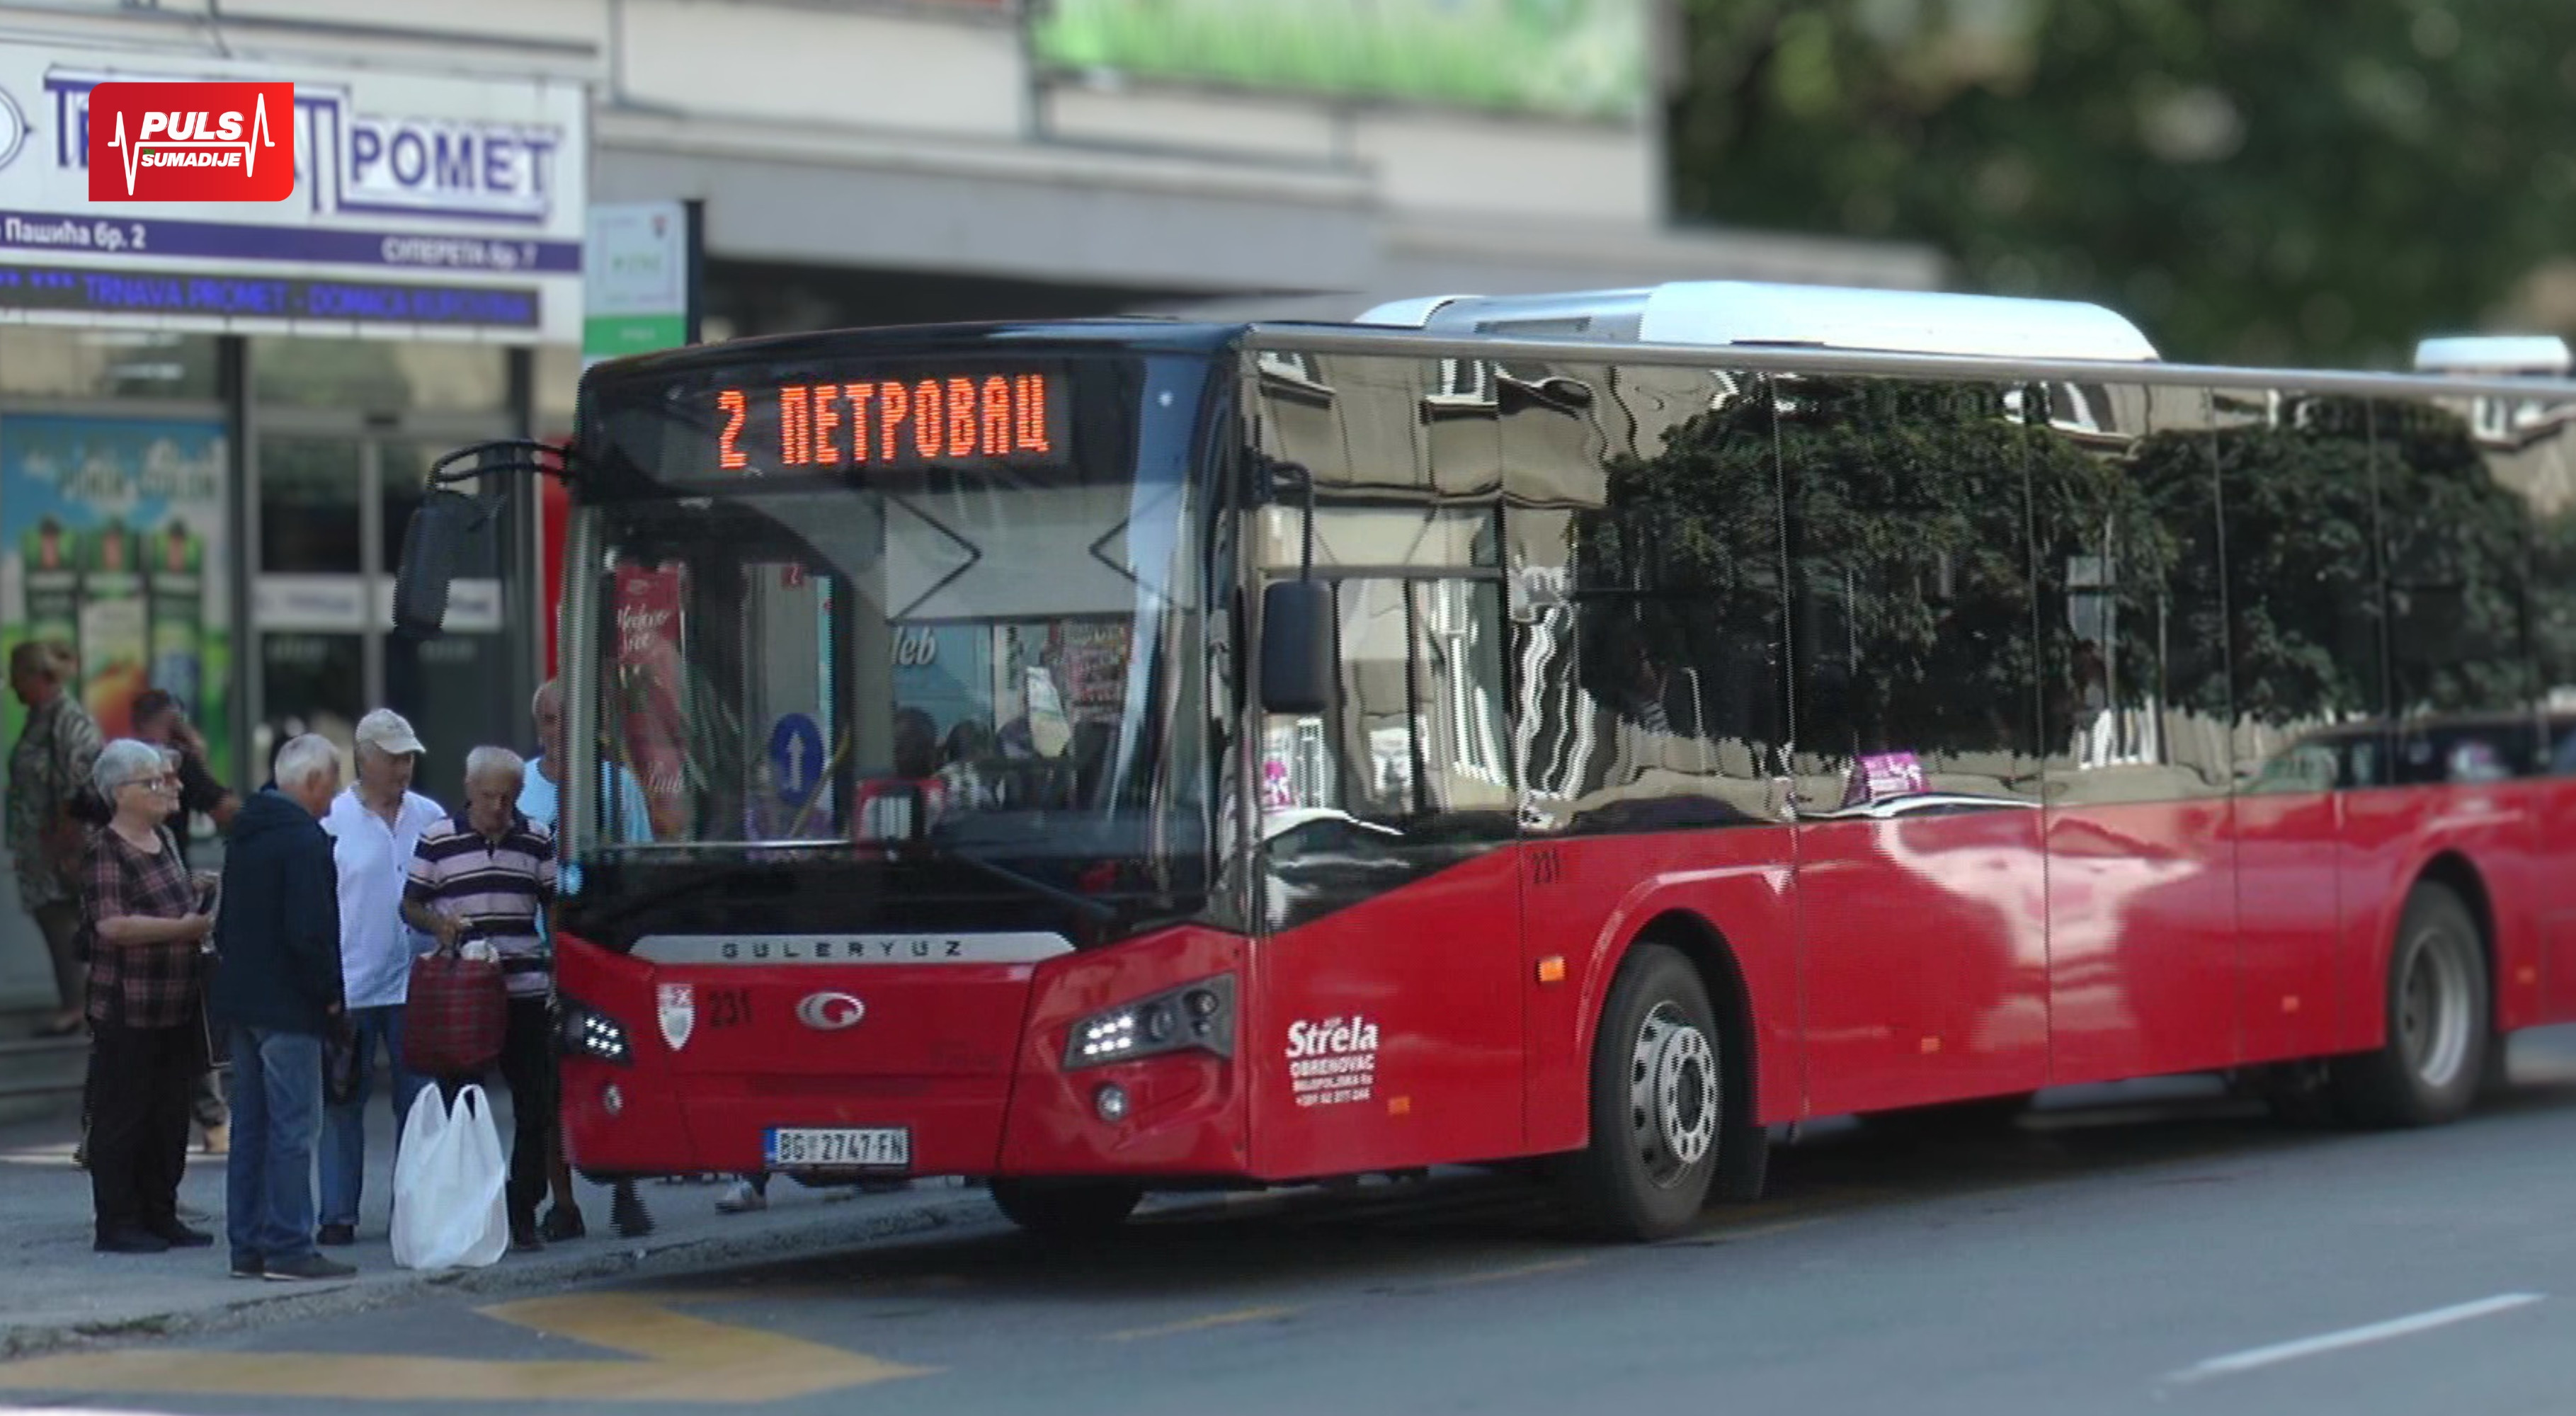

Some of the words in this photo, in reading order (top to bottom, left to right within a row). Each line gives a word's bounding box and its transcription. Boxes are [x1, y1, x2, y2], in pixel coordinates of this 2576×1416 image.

[131, 224, 146, 249] 2
[717, 390, 748, 469] 2
[780, 374, 1049, 465] ПЕТРОВАЦ
[709, 988, 753, 1029] 231
[1284, 1015, 1379, 1058] Strela
[780, 1133, 805, 1160] BG
